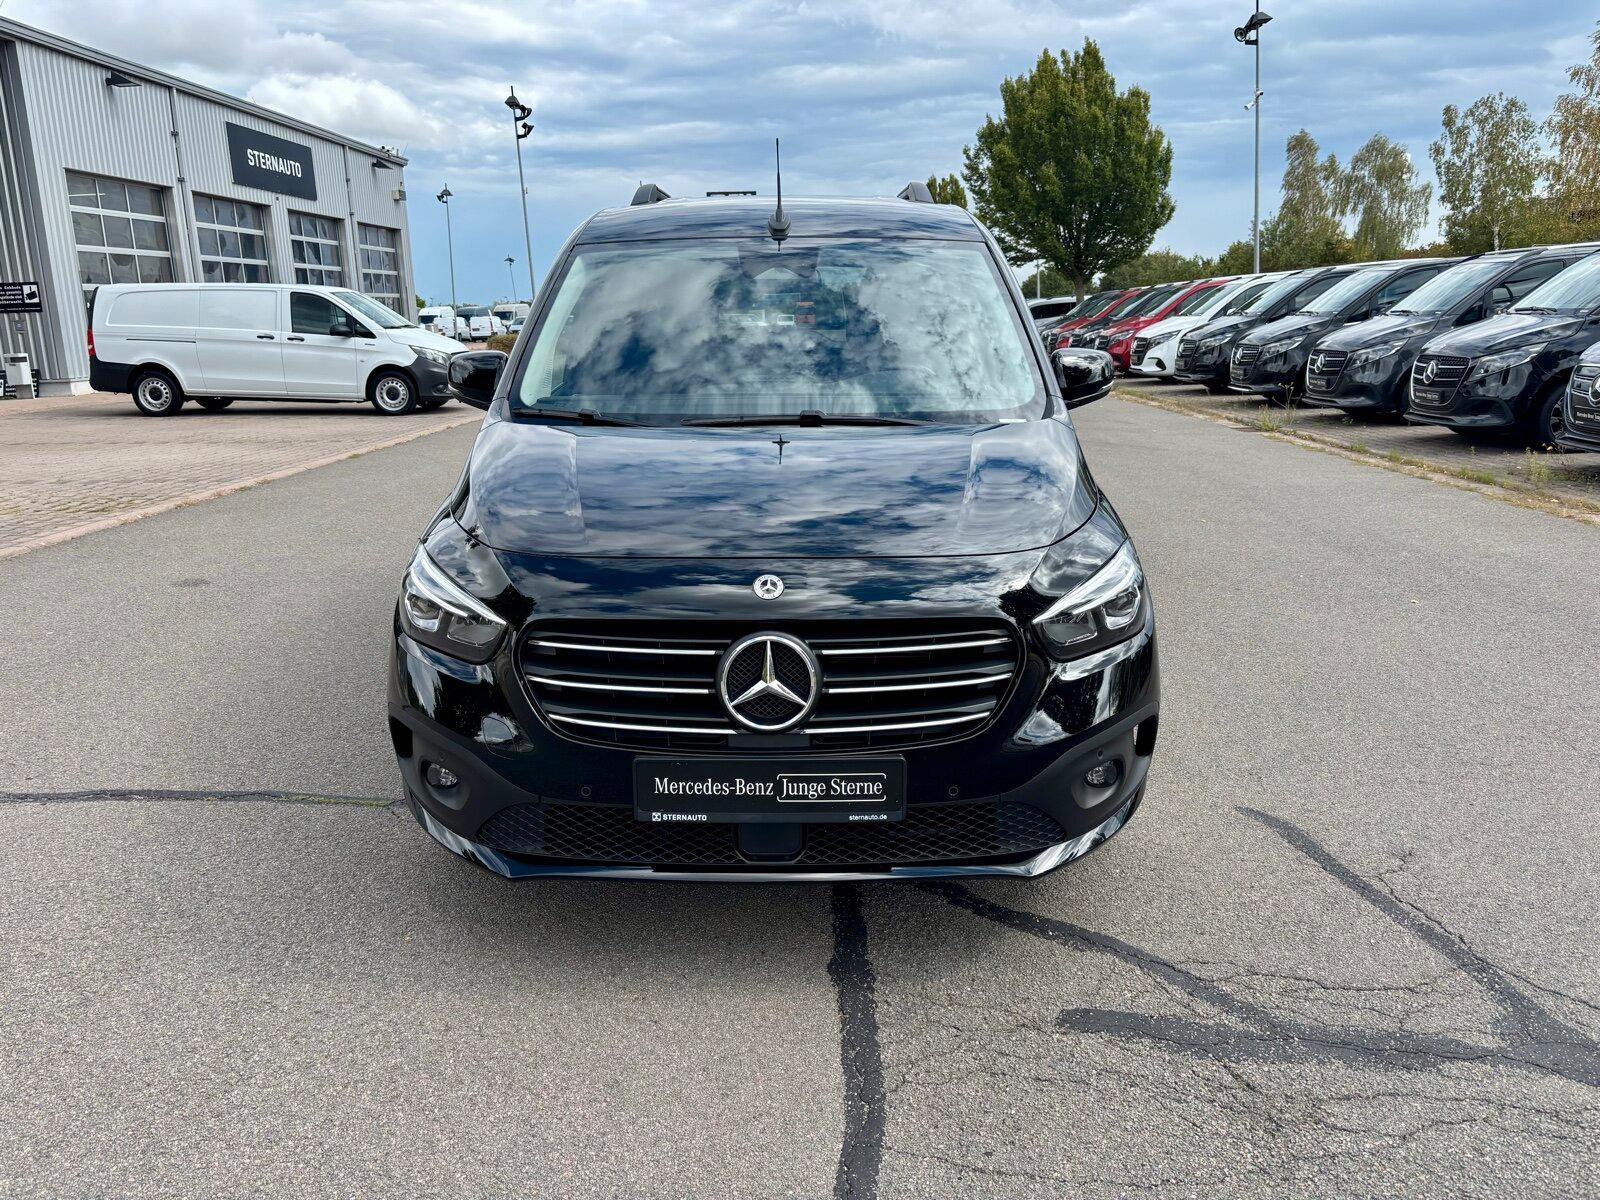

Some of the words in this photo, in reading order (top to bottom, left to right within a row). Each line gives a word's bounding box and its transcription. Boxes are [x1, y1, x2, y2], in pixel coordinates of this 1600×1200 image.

[247, 148, 302, 178] STERNAUTO
[654, 777, 774, 796] Mercedes-Benz
[781, 778, 826, 799] Junge
[830, 778, 883, 796] Sterne
[662, 813, 707, 821] STERNAUTO
[849, 813, 887, 821] sternauto.de
